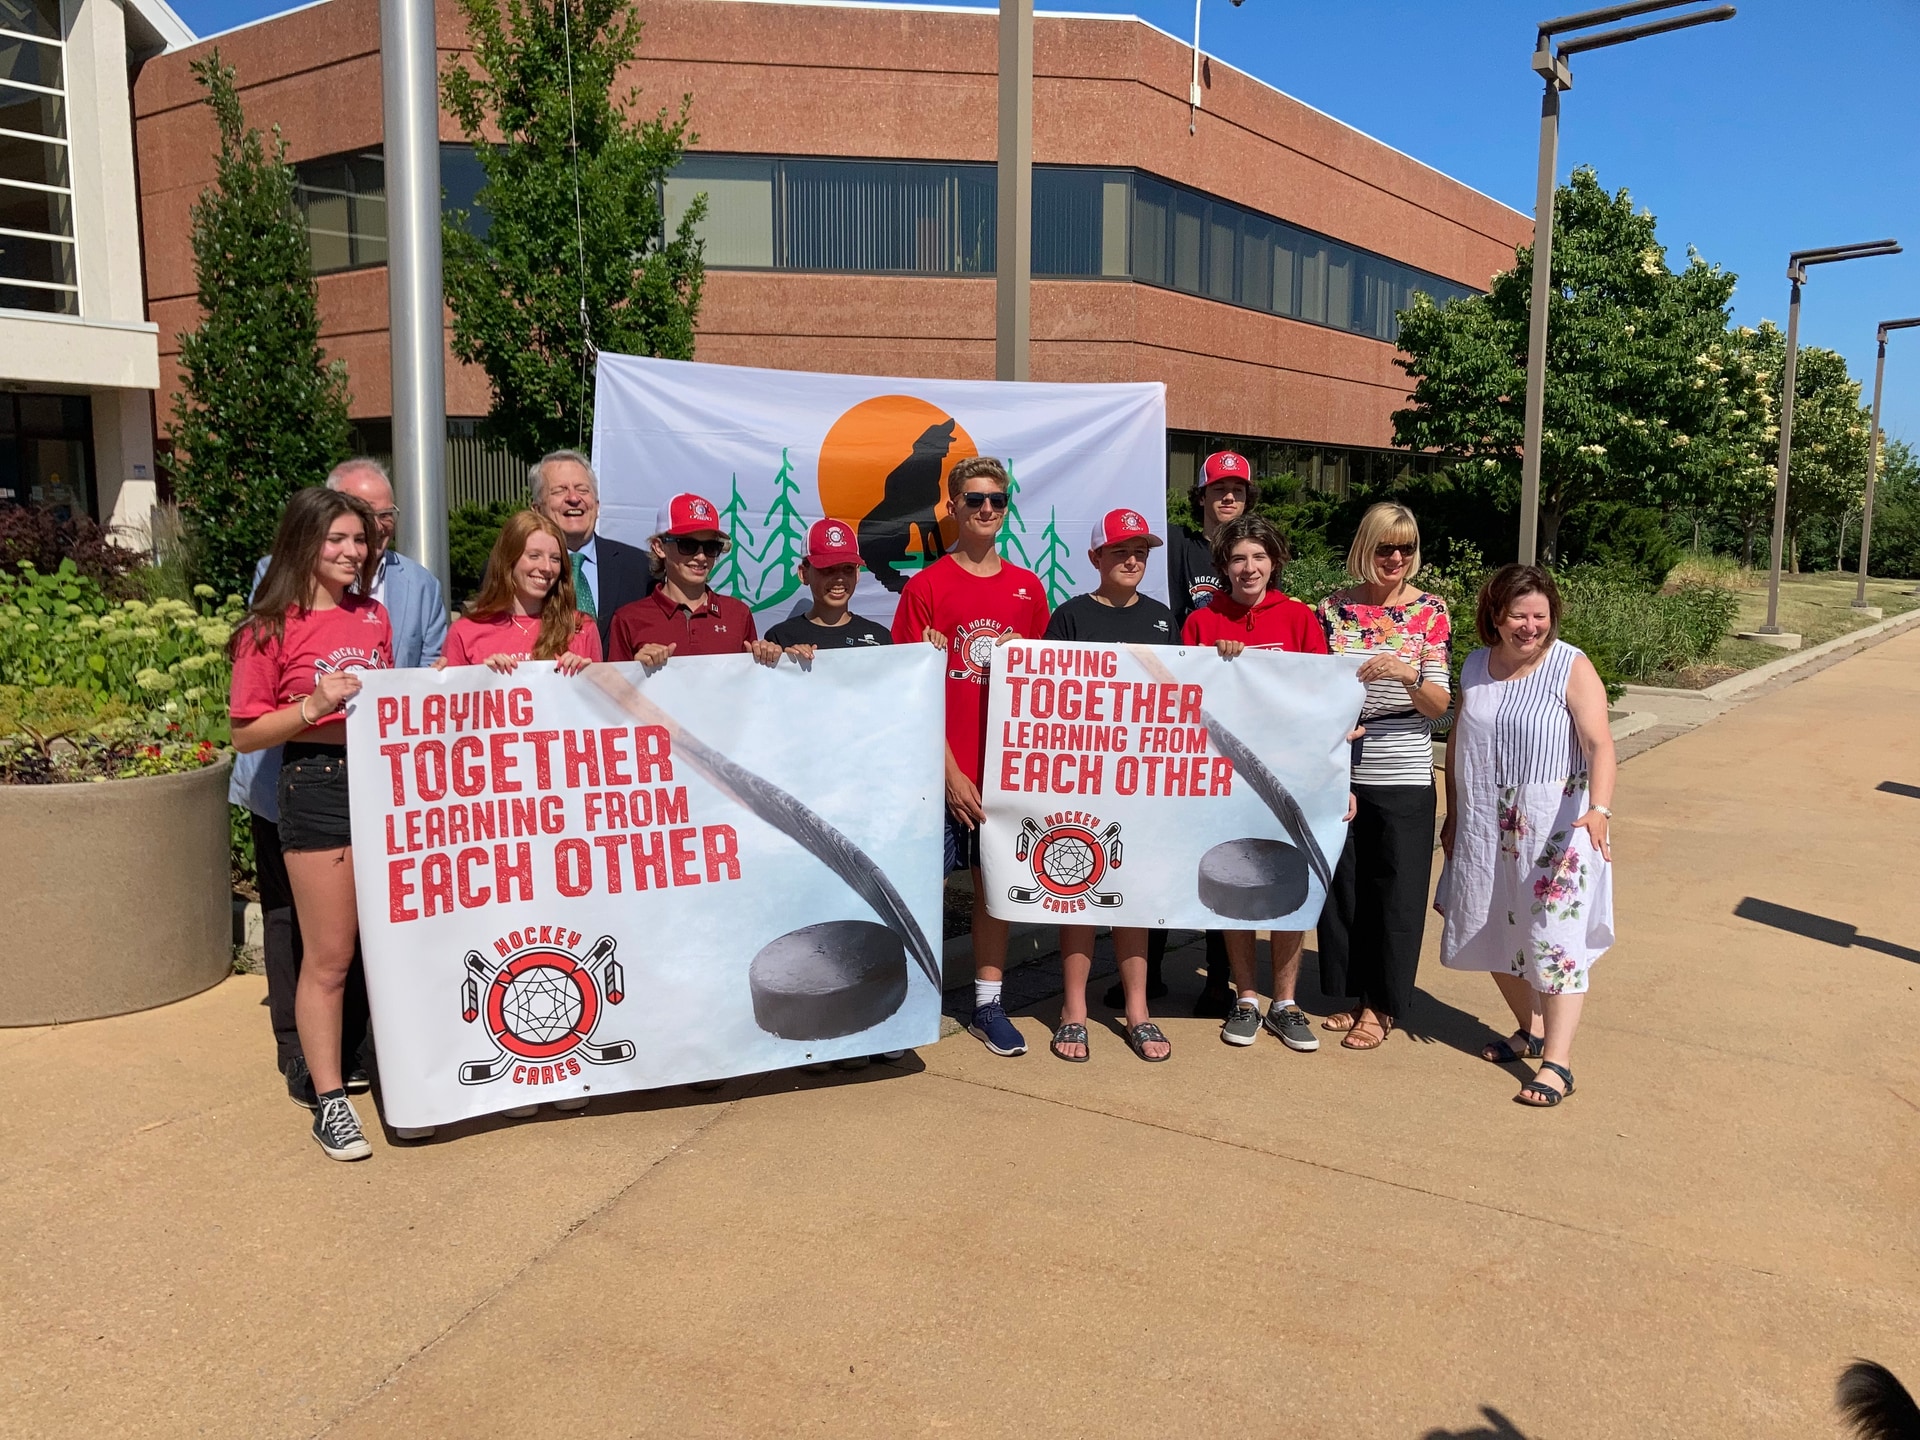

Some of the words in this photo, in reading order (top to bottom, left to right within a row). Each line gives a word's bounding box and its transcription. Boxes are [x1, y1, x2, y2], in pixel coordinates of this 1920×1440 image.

[1195, 575, 1222, 588] HOCKE
[968, 618, 1002, 631] HOCKEY
[328, 646, 365, 662] HOCKEY
[1007, 647, 1117, 677] PLAYING
[377, 687, 533, 739] PLAYING
[1006, 677, 1202, 724] TOGETHER
[1003, 721, 1127, 752] LEARNING
[1139, 727, 1207, 753] FROM
[379, 725, 674, 806] TOGETHER
[1000, 752, 1102, 794] EACH
[1115, 756, 1233, 796] OTHER
[385, 795, 564, 855] LEARNING
[584, 786, 688, 832] FROM
[1044, 811, 1100, 829] HOCKEY
[388, 841, 533, 923] EACH
[554, 823, 742, 897] OTHER
[1042, 897, 1086, 913] CARES
[493, 925, 582, 957] HOCKEY
[513, 1057, 581, 1086] CARES
